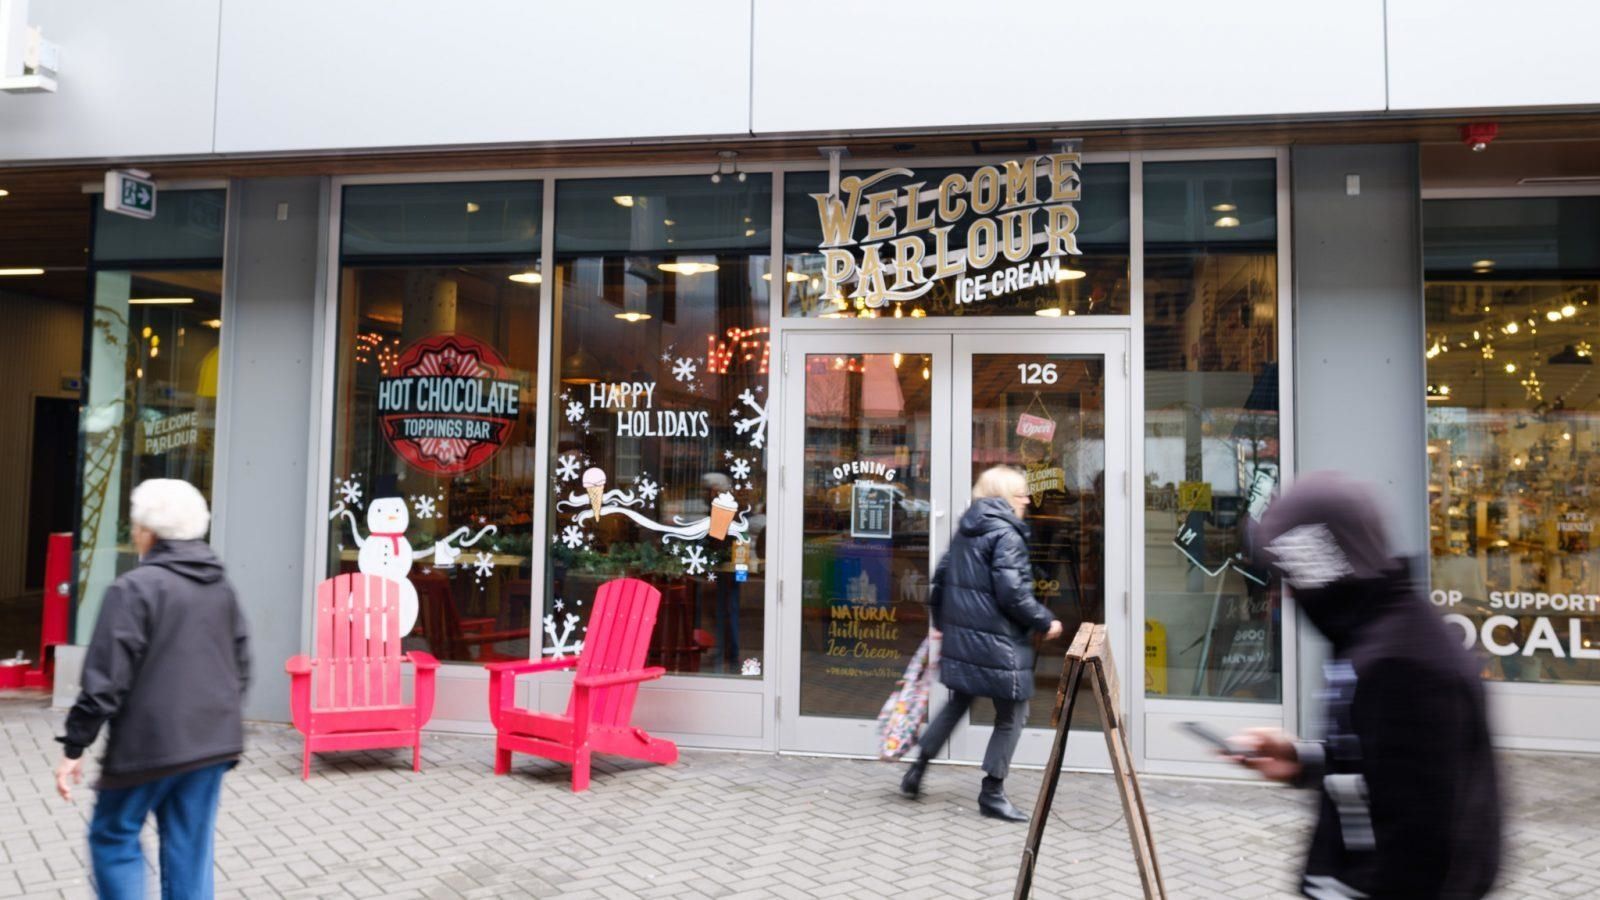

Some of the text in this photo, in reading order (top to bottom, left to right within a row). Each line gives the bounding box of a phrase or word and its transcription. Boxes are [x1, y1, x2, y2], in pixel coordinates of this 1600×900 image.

[808, 152, 1082, 248] WELCOME
[818, 205, 1083, 307] PARLOUR
[955, 277, 987, 305] ICE
[991, 258, 1061, 298] CREAM
[1018, 363, 1058, 385] 126
[378, 377, 519, 414] HOT CHOCOLATE
[589, 382, 656, 409] HAPPY
[143, 411, 198, 437] WELCOME
[403, 418, 490, 439] TOPPINGS BAR
[617, 410, 709, 438] HOLIDAYS
[1022, 421, 1050, 437] Open
[145, 430, 198, 455] PARLOUR
[833, 461, 896, 482] OPENING
[1025, 468, 1057, 483] ELCOME
[831, 604, 897, 621] NATURAL
[1430, 589, 1598, 612] OP SUPPORT
[1442, 613, 1600, 660] OCAL
